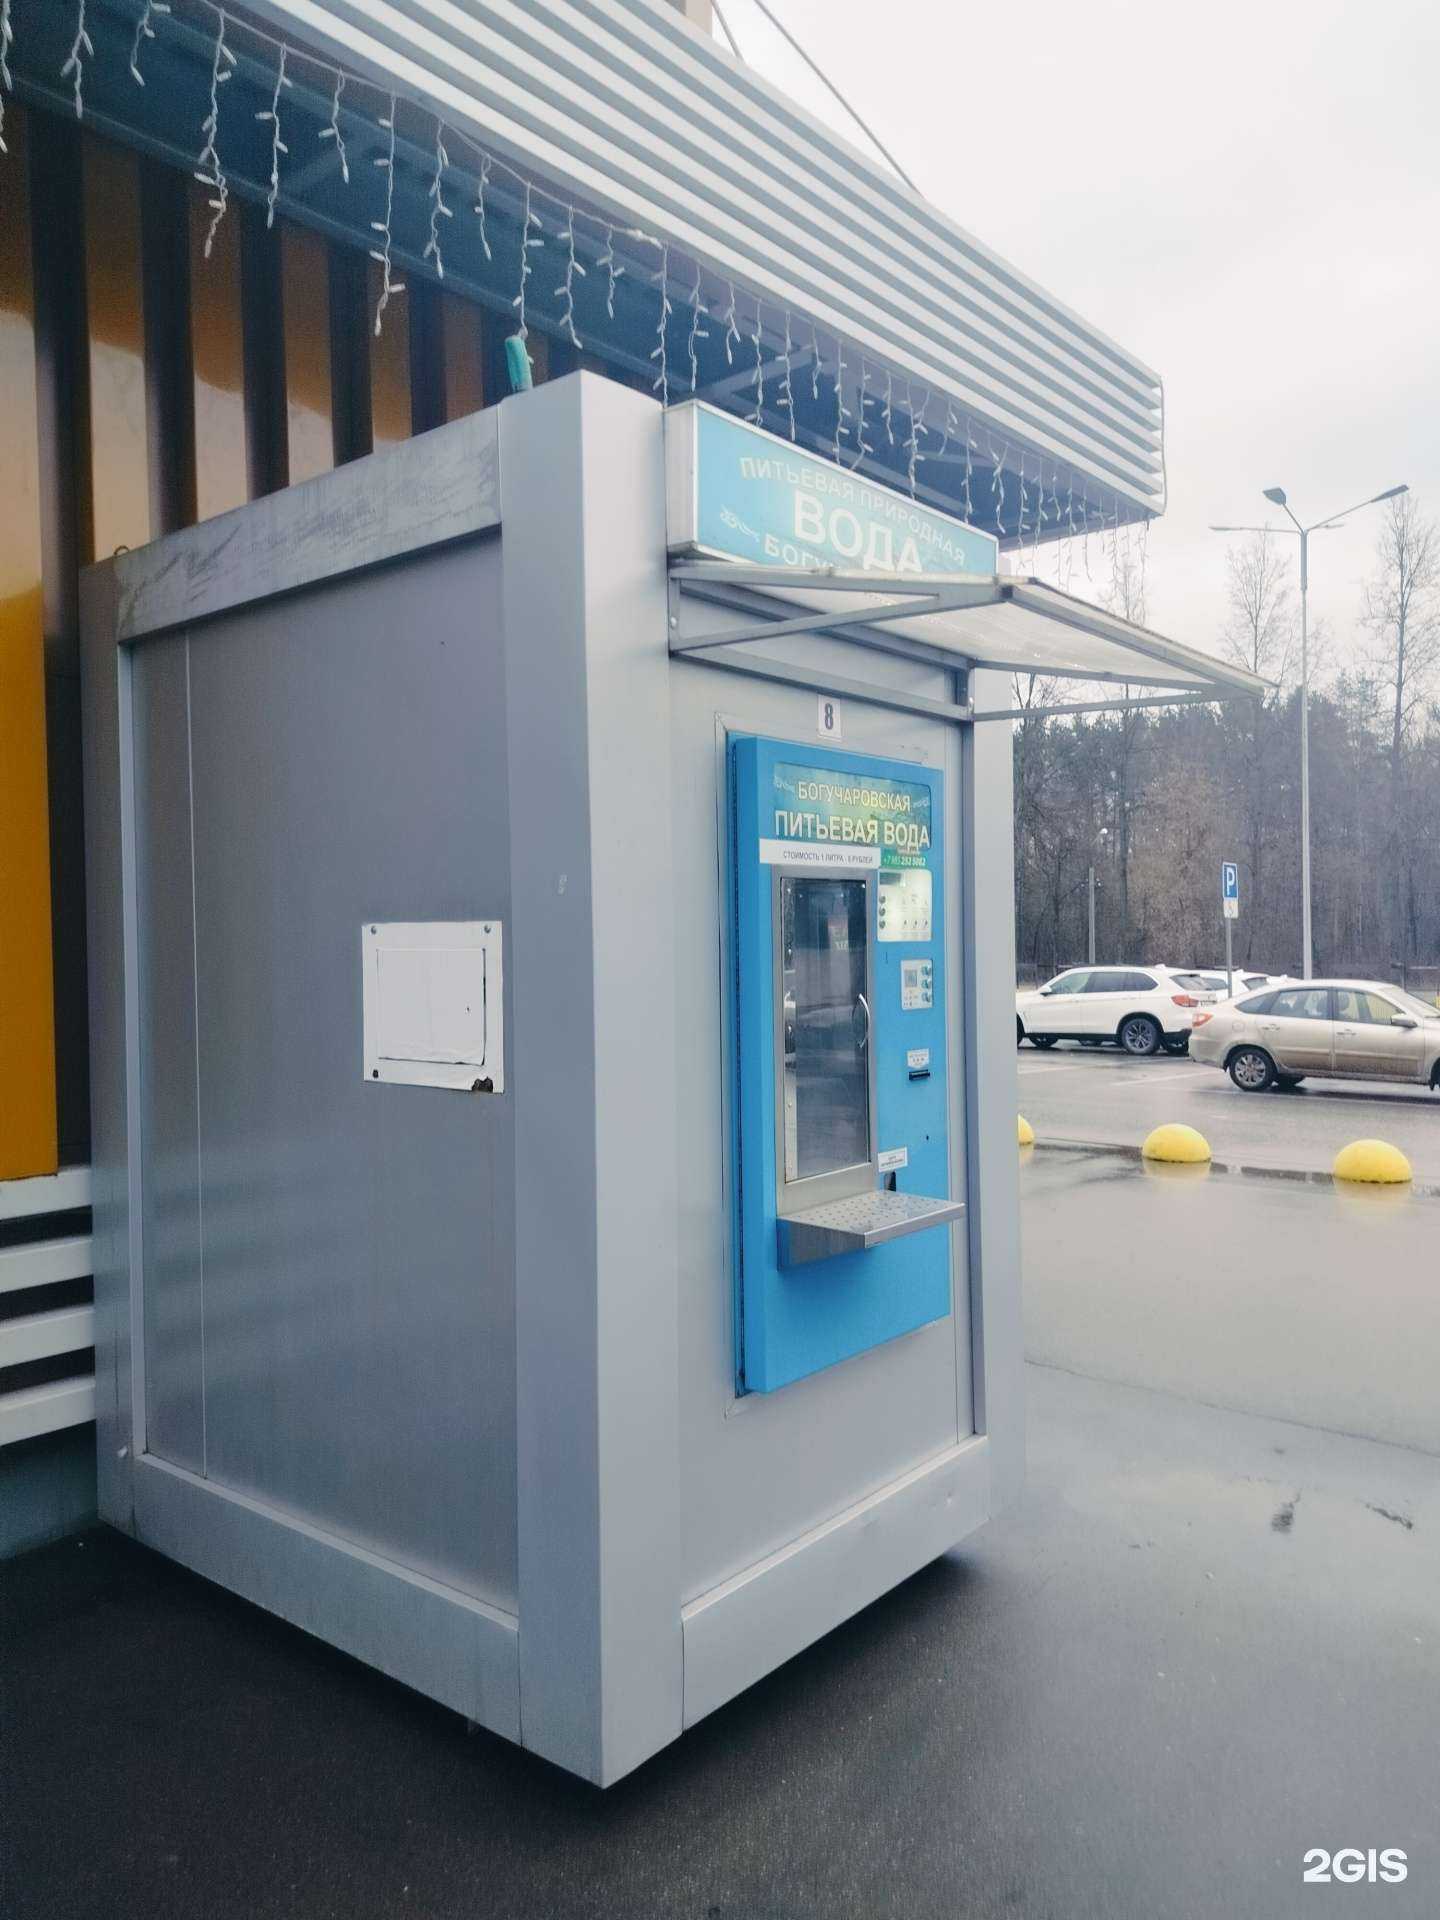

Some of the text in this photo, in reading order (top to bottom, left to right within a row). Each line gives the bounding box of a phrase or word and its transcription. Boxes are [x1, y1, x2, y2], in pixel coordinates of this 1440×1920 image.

[740, 457, 966, 565] ПИТЬЕВАЯ ПРИРОДНАЯ
[794, 488, 922, 573] ВОДА
[824, 702, 834, 730] 8
[798, 781, 911, 812] БОГУЧАРОВСКАЯ
[775, 810, 931, 853] ПИТЬЕВАЯ ВОДА
[783, 850, 820, 861] СТОИМОСТЬ
